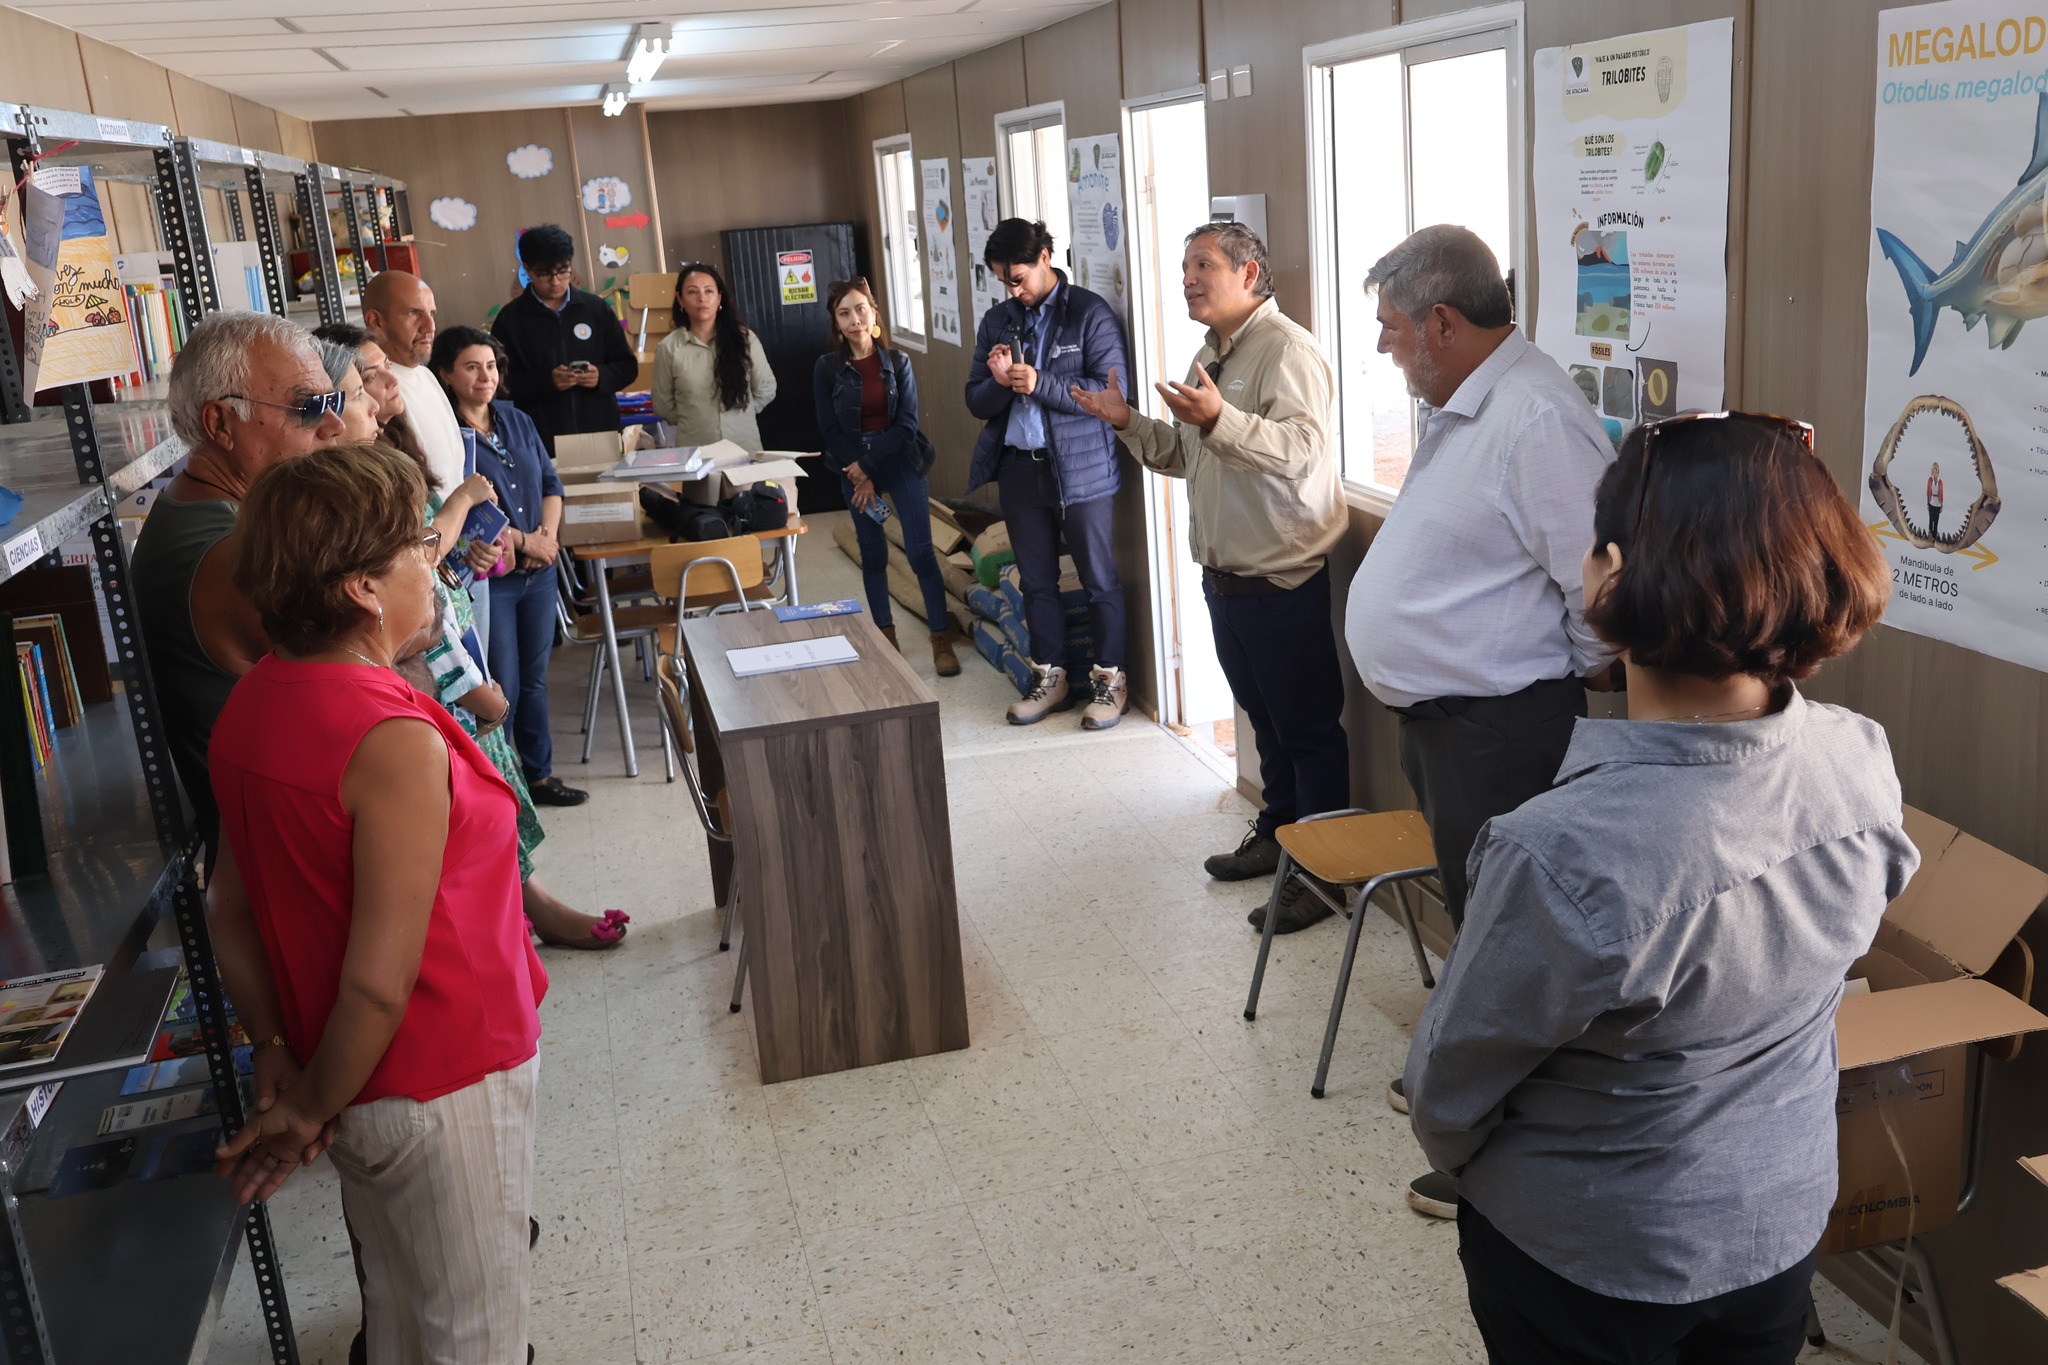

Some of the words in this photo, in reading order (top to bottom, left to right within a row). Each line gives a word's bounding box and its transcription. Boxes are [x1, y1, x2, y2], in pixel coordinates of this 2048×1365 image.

[1616, 52, 1631, 60] PASADO
[1602, 66, 1646, 86] TRILOBITES
[1882, 79, 1950, 104] Otodus
[1595, 136, 1604, 144] SON
[1605, 135, 1614, 143] LOS
[1586, 147, 1612, 157] TRILOBITES?
[1597, 211, 1644, 229] INFORMACIÓN
[1592, 344, 1611, 356] FÓSILES
[136, 496, 146, 505] Q
[10, 537, 39, 566] CIENCIAS
[1944, 566, 1954, 576] de
[1893, 568, 1900, 582] 2
[1904, 571, 1958, 597] METROS
[1899, 589, 1908, 599] de
[1910, 592, 1926, 604] lado
[1936, 599, 1953, 611] lado
[1848, 1194, 1920, 1216] COLOMBIA
